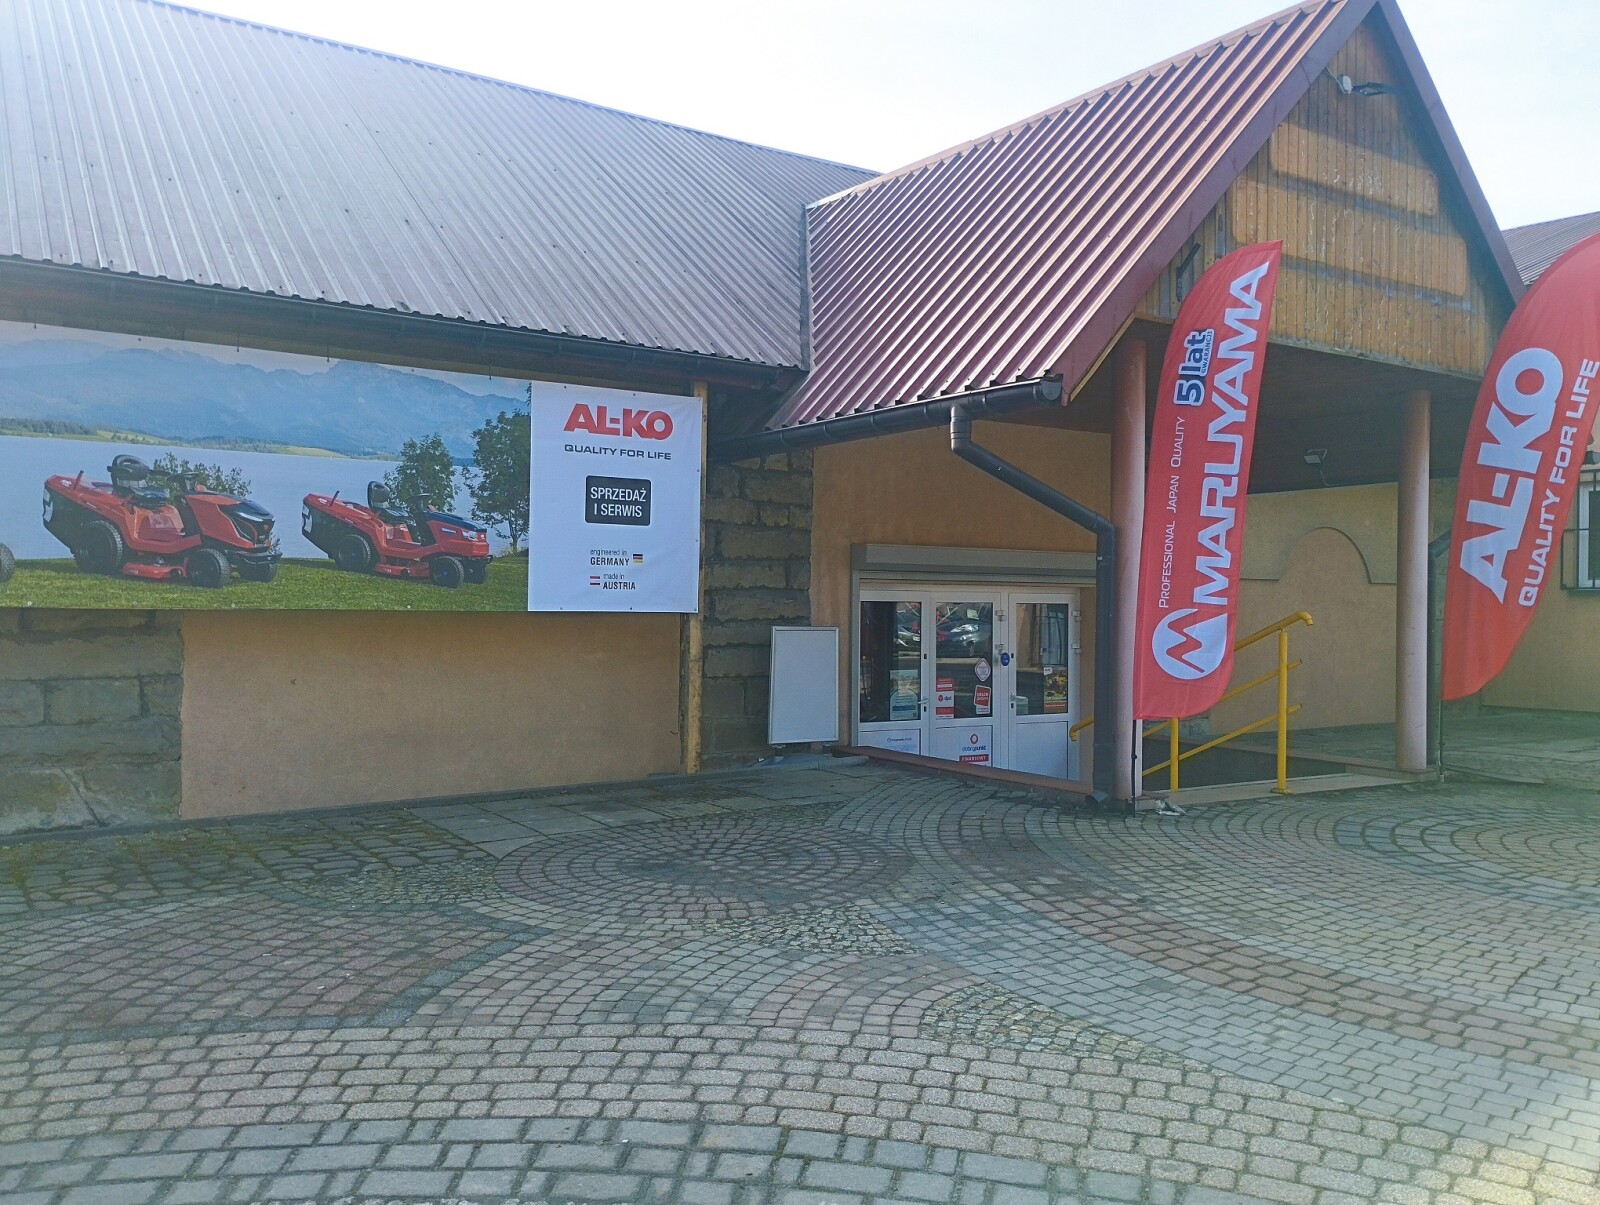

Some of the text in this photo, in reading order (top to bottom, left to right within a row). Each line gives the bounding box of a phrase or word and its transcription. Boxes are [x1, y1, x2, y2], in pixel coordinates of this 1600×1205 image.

[1176, 334, 1206, 402] 5 lat
[1201, 330, 1212, 374] GWARANCJI
[563, 402, 673, 440] AL-KO
[1194, 261, 1269, 605] MARUYAMA
[564, 444, 672, 460] QUALITY FOR LIFE
[590, 486, 646, 502] SPRZEDAŻ
[1460, 347, 1564, 604] AL-KO
[1518, 358, 1600, 607] QUALITY FOR LIFE
[601, 504, 642, 518] SERWIS
[1158, 416, 1185, 608] PROFESSIONAL JAPAN QUALITY
[590, 557, 629, 566] GERMANY
[603, 582, 636, 590] AUSTRIA
